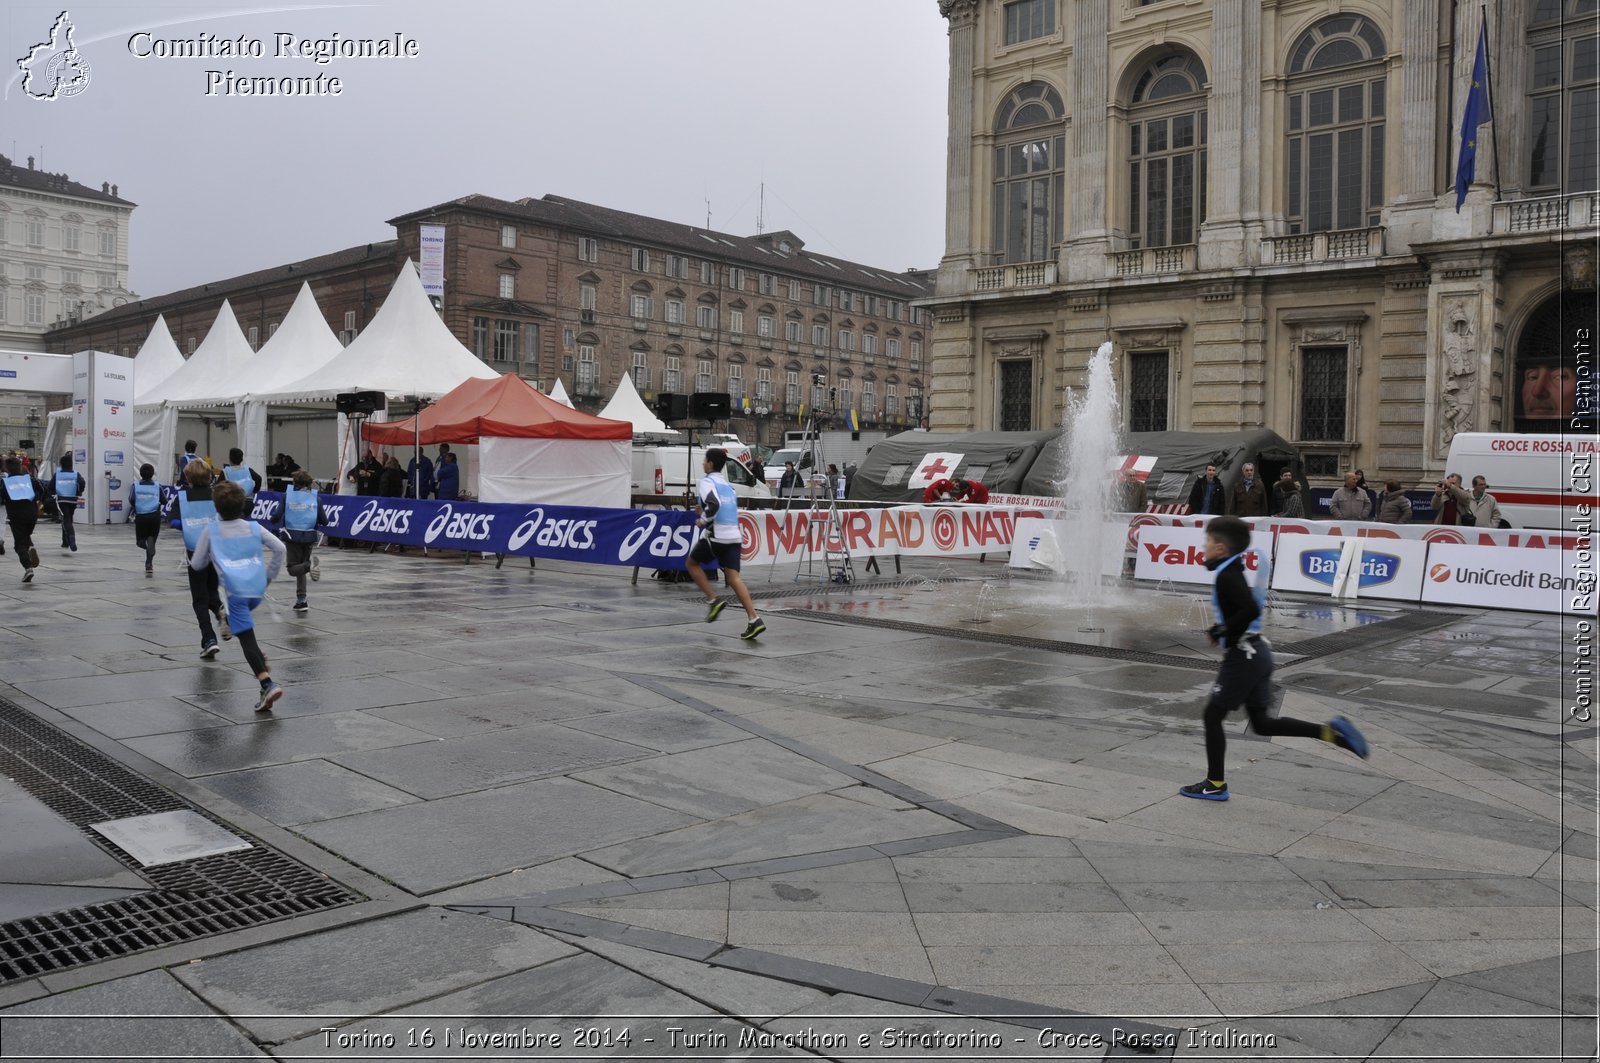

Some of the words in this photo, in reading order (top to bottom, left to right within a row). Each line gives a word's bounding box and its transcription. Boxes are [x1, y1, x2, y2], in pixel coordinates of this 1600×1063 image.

[1491, 439, 1529, 452] CROCE
[1532, 440, 1573, 453] ROSSA
[988, 495, 1004, 504] ROCE
[1006, 496, 1030, 506] ROSSA
[1143, 543, 1259, 571] Yakt
[1308, 556, 1389, 577] Baria
[1456, 567, 1535, 589] UniCredit
